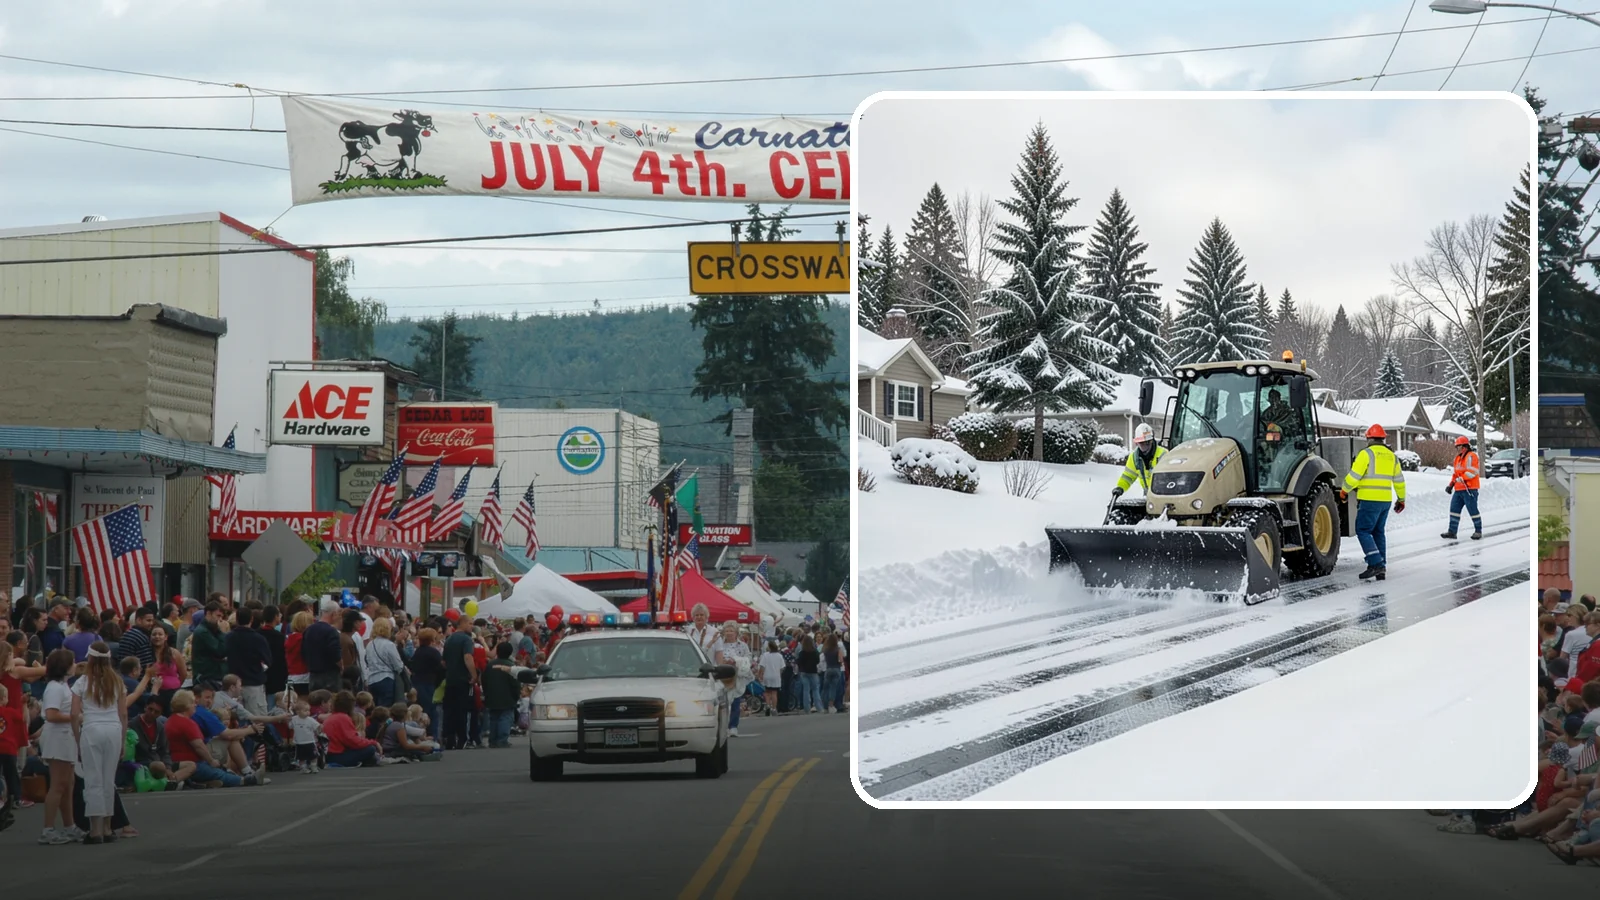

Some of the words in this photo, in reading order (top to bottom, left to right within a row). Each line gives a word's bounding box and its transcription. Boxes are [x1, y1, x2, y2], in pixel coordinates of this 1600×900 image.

[481, 141, 605, 193] JULY
[632, 149, 747, 198] 4th.
[696, 253, 850, 280] CROSSWA
[283, 380, 374, 420] ACE
[405, 409, 453, 422] CEDAR
[283, 420, 371, 437] Hardware
[95, 485, 124, 495] Vincent
[127, 486, 136, 495] de
[138, 486, 155, 495] Paul
[688, 526, 742, 535] CRNATION
[699, 535, 730, 544] GLASS
